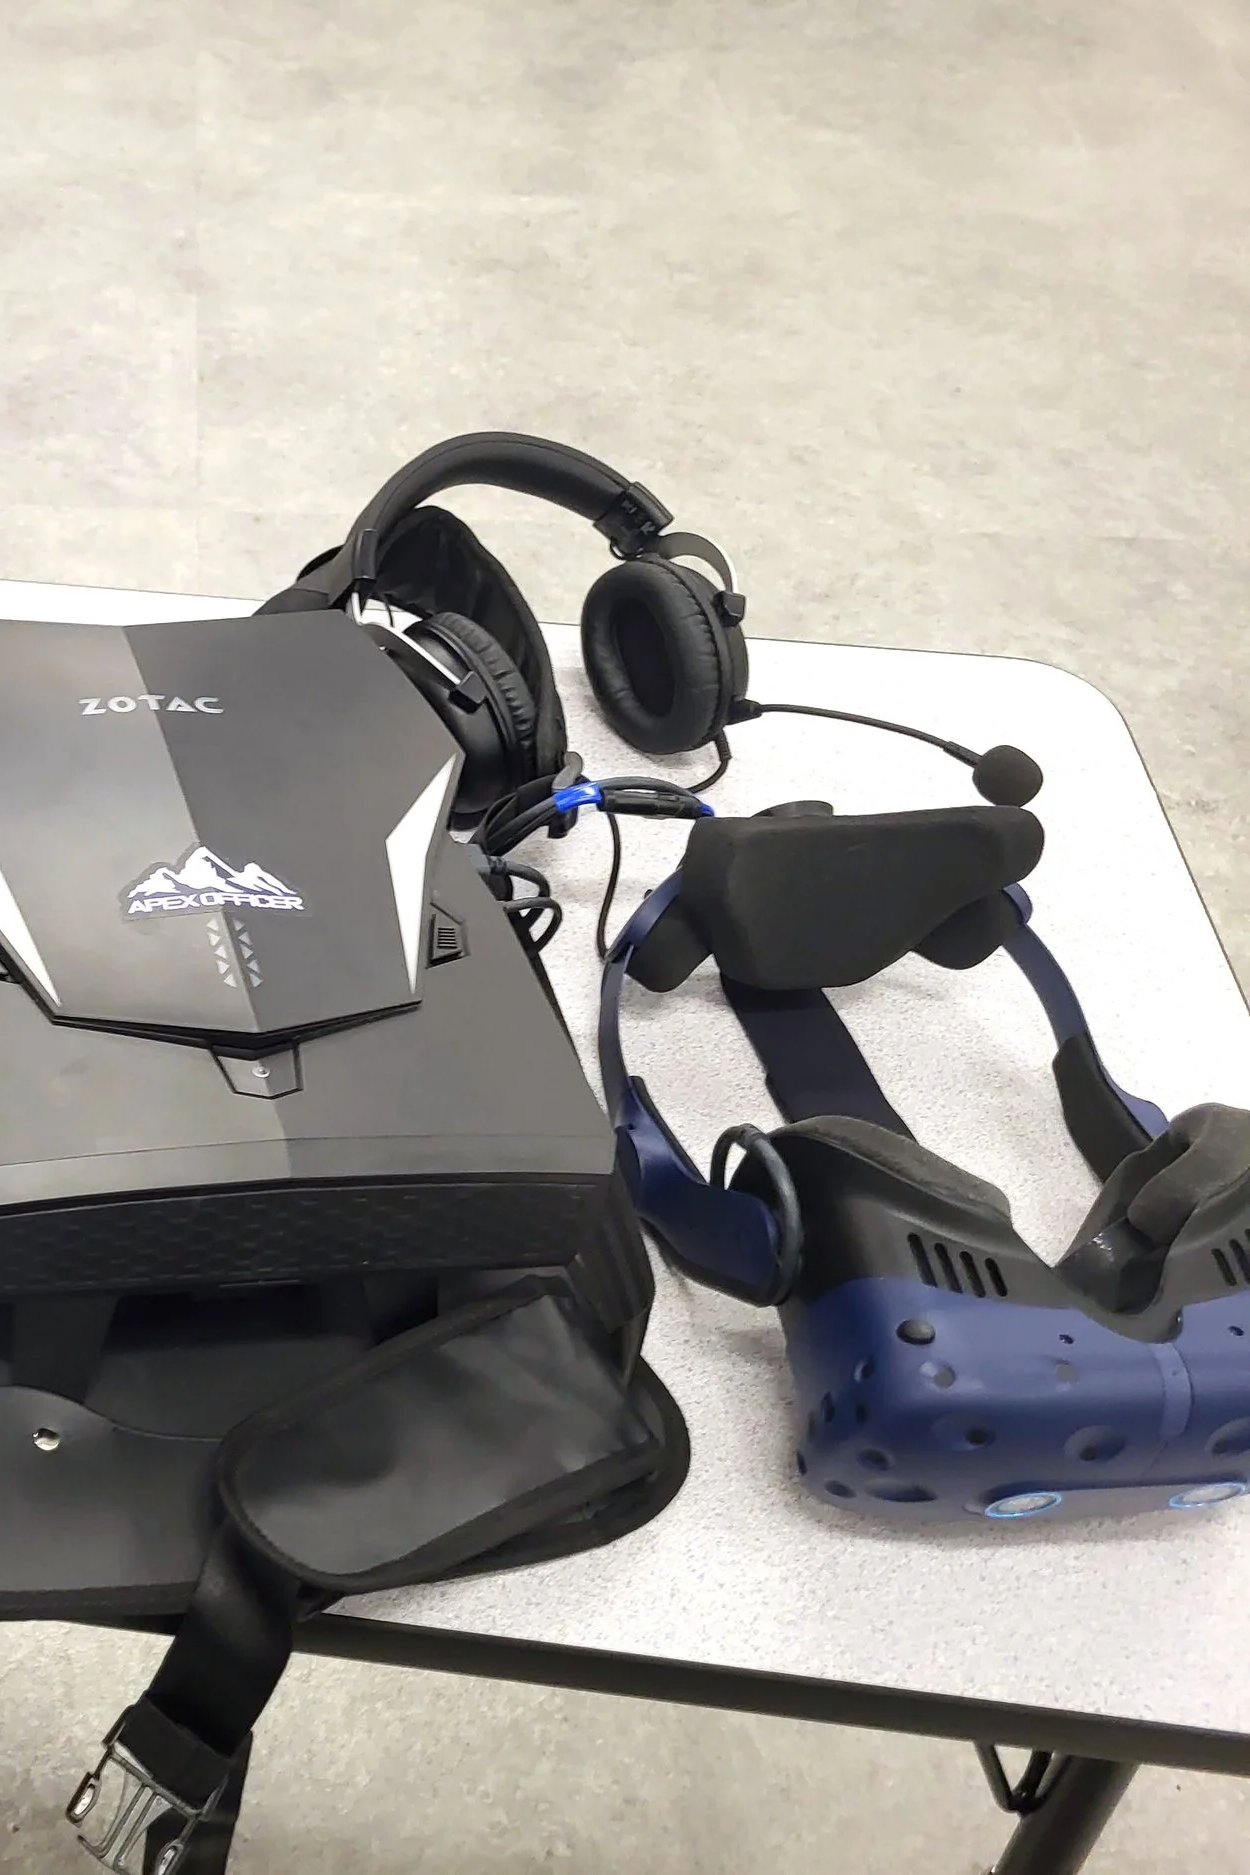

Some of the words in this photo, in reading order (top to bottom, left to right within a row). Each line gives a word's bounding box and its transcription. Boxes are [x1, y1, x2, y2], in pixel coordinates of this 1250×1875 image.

[78, 694, 224, 715] ZOTAC
[128, 894, 200, 913] APEX
[200, 892, 304, 910] OFFICER
